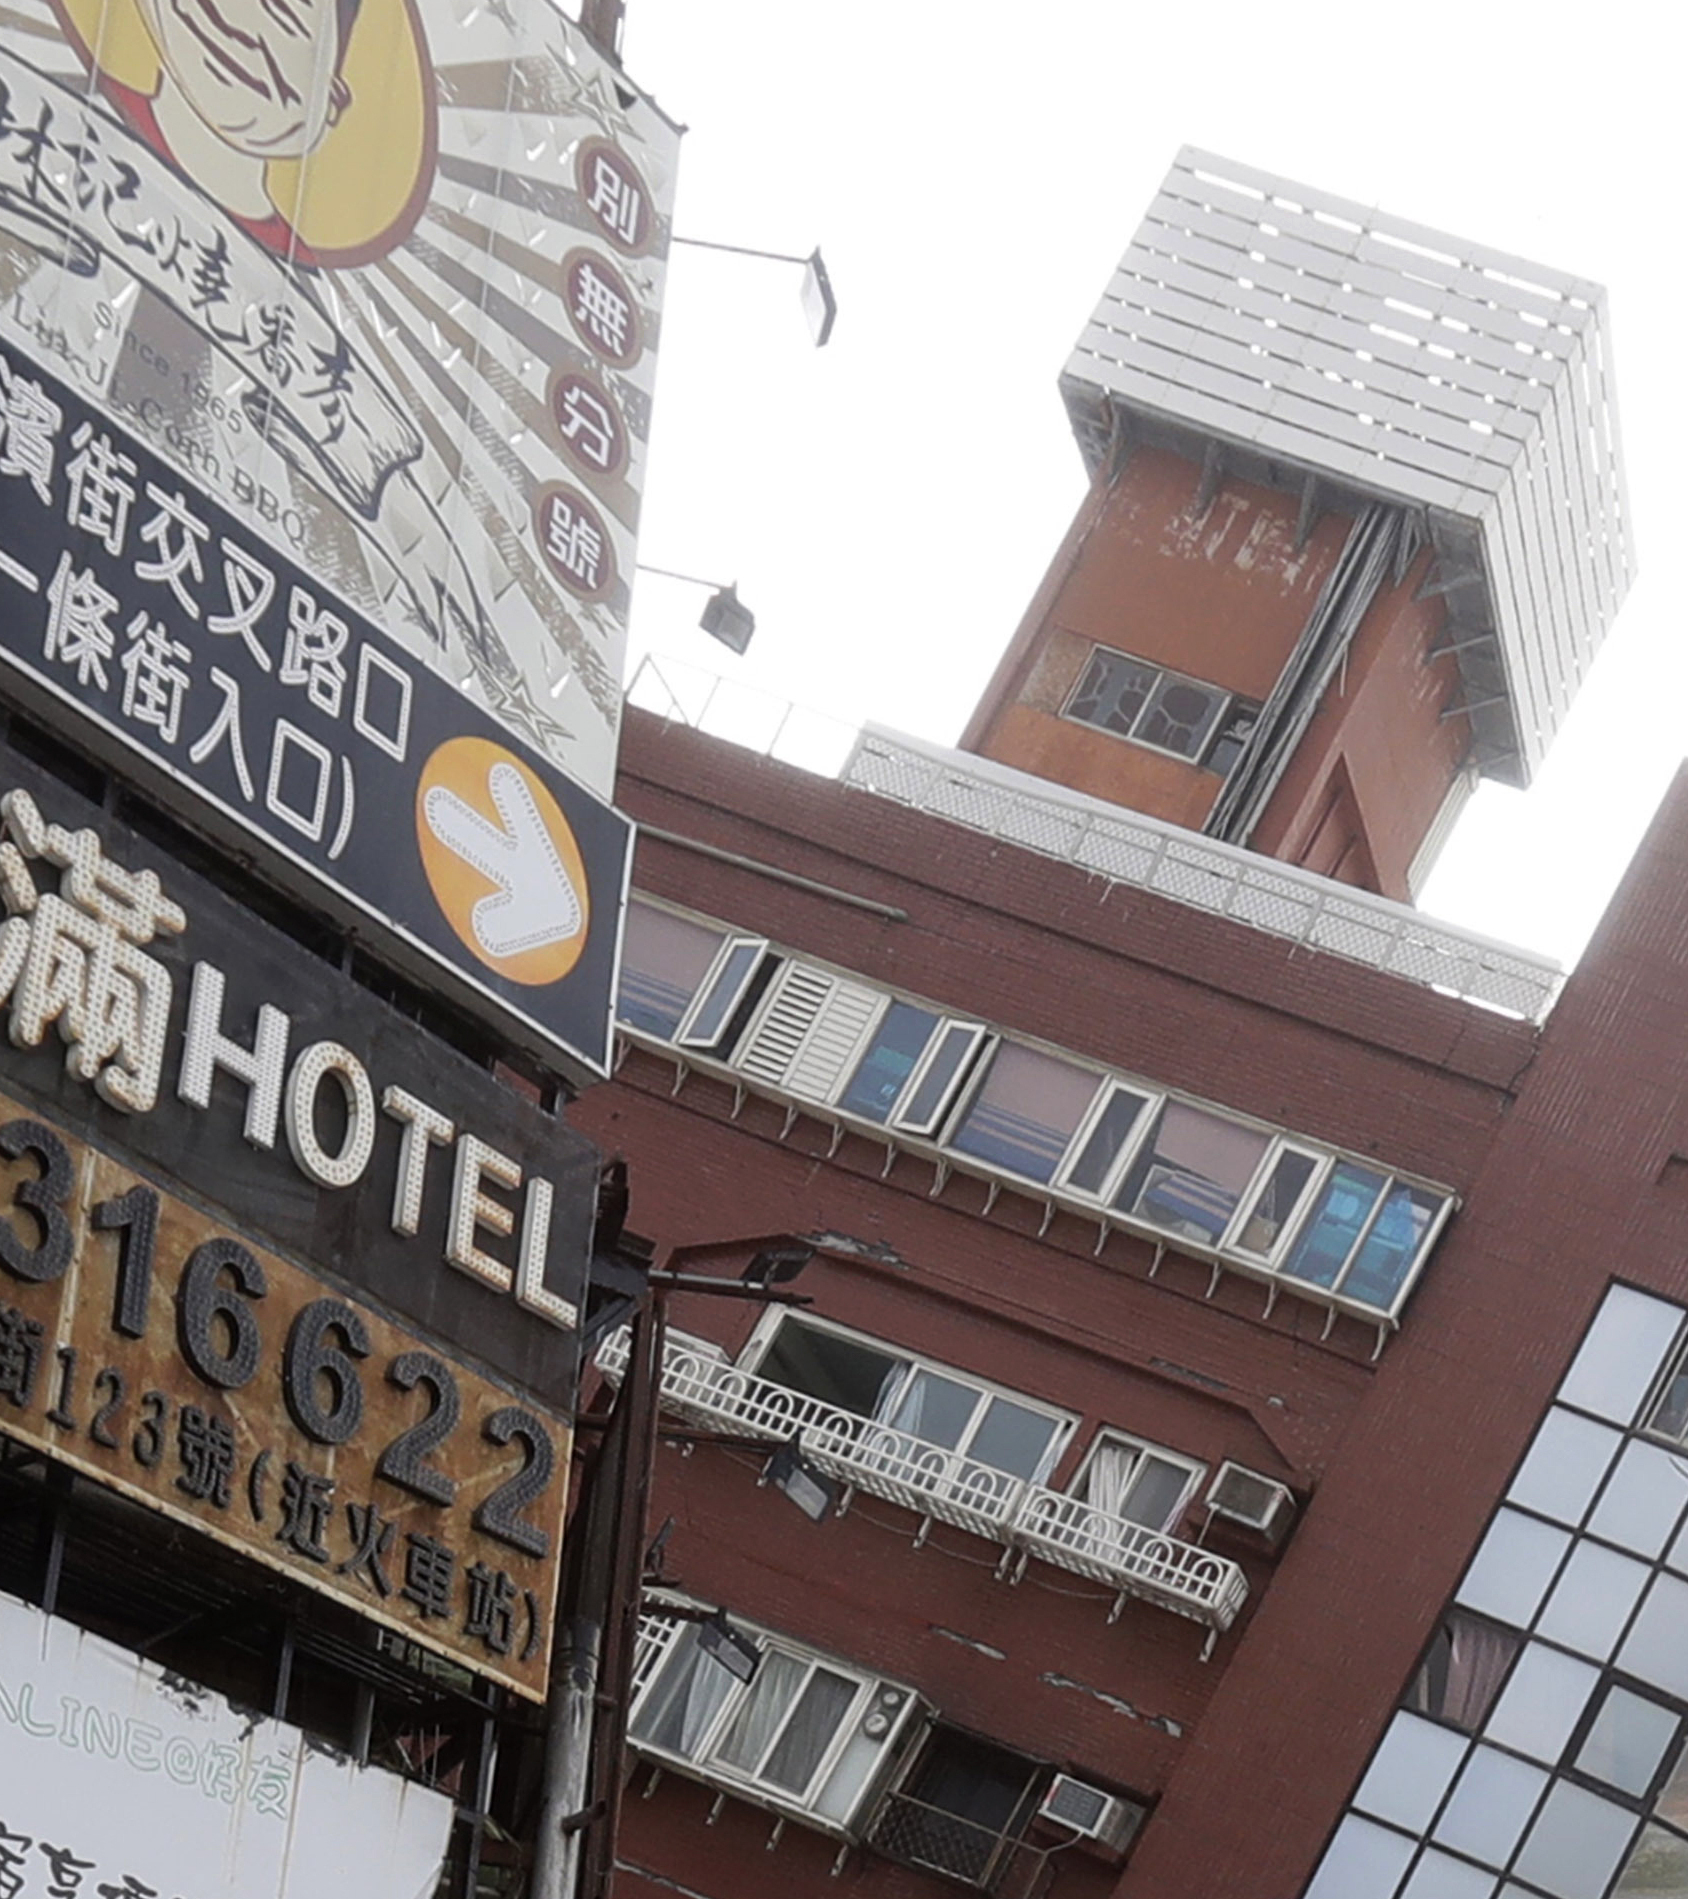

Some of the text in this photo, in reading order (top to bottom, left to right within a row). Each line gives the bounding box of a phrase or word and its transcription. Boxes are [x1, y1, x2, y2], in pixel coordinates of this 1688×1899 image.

[546, 153, 642, 593] 別無分號
[231, 464, 306, 552] BBQ
